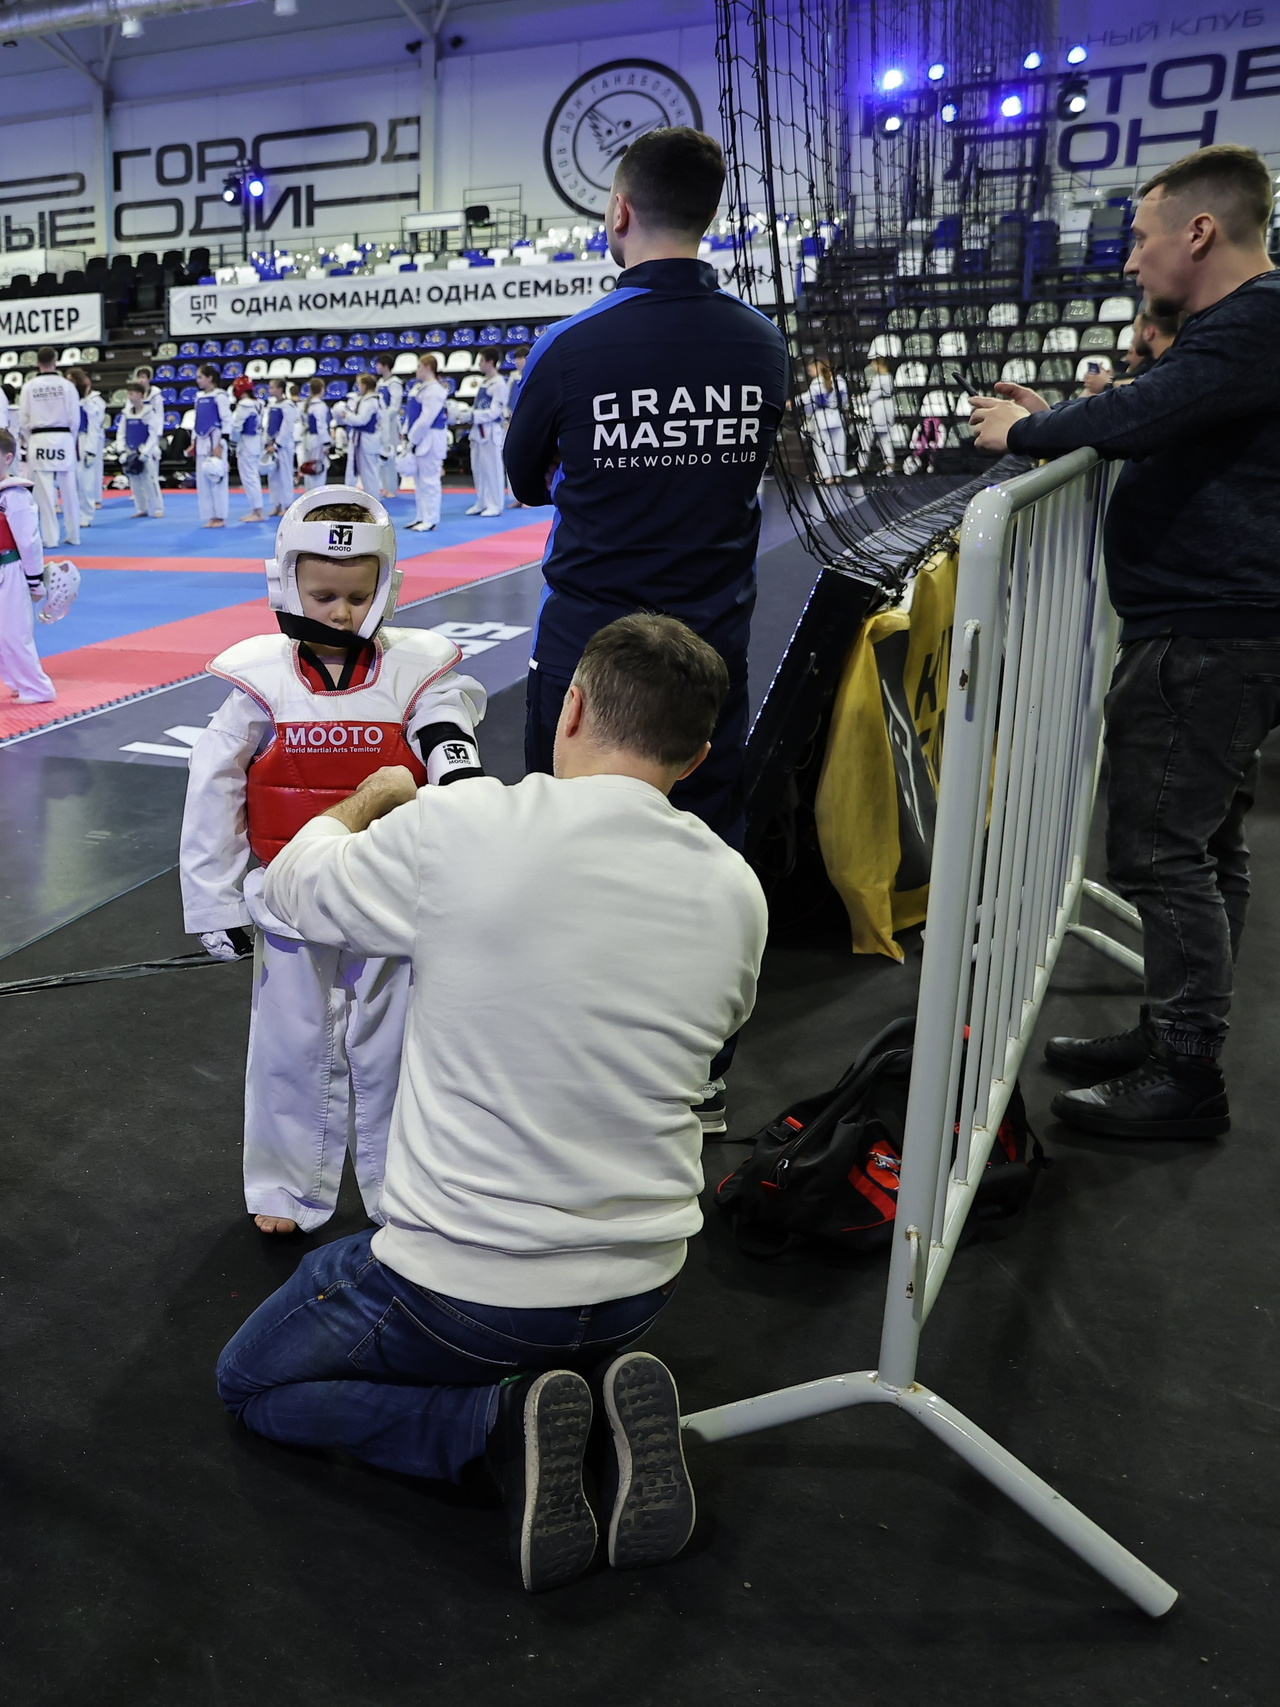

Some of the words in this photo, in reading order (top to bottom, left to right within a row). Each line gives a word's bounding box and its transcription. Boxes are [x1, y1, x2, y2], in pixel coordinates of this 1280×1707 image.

[1170, 9, 1264, 36] КЛУБ
[230, 295, 293, 316] ОДНА
[299, 287, 420, 312] КОМАНДА!
[426, 283, 497, 306] ОДНА
[503, 277, 592, 299] СЕМЬЯ!
[592, 384, 763, 421] GRAND
[593, 418, 761, 450] MASTER
[36, 448, 66, 461] RUS
[593, 453, 712, 469] TAEKWONDO
[721, 451, 757, 464] CLUB
[285, 726, 384, 746] MOOTO
